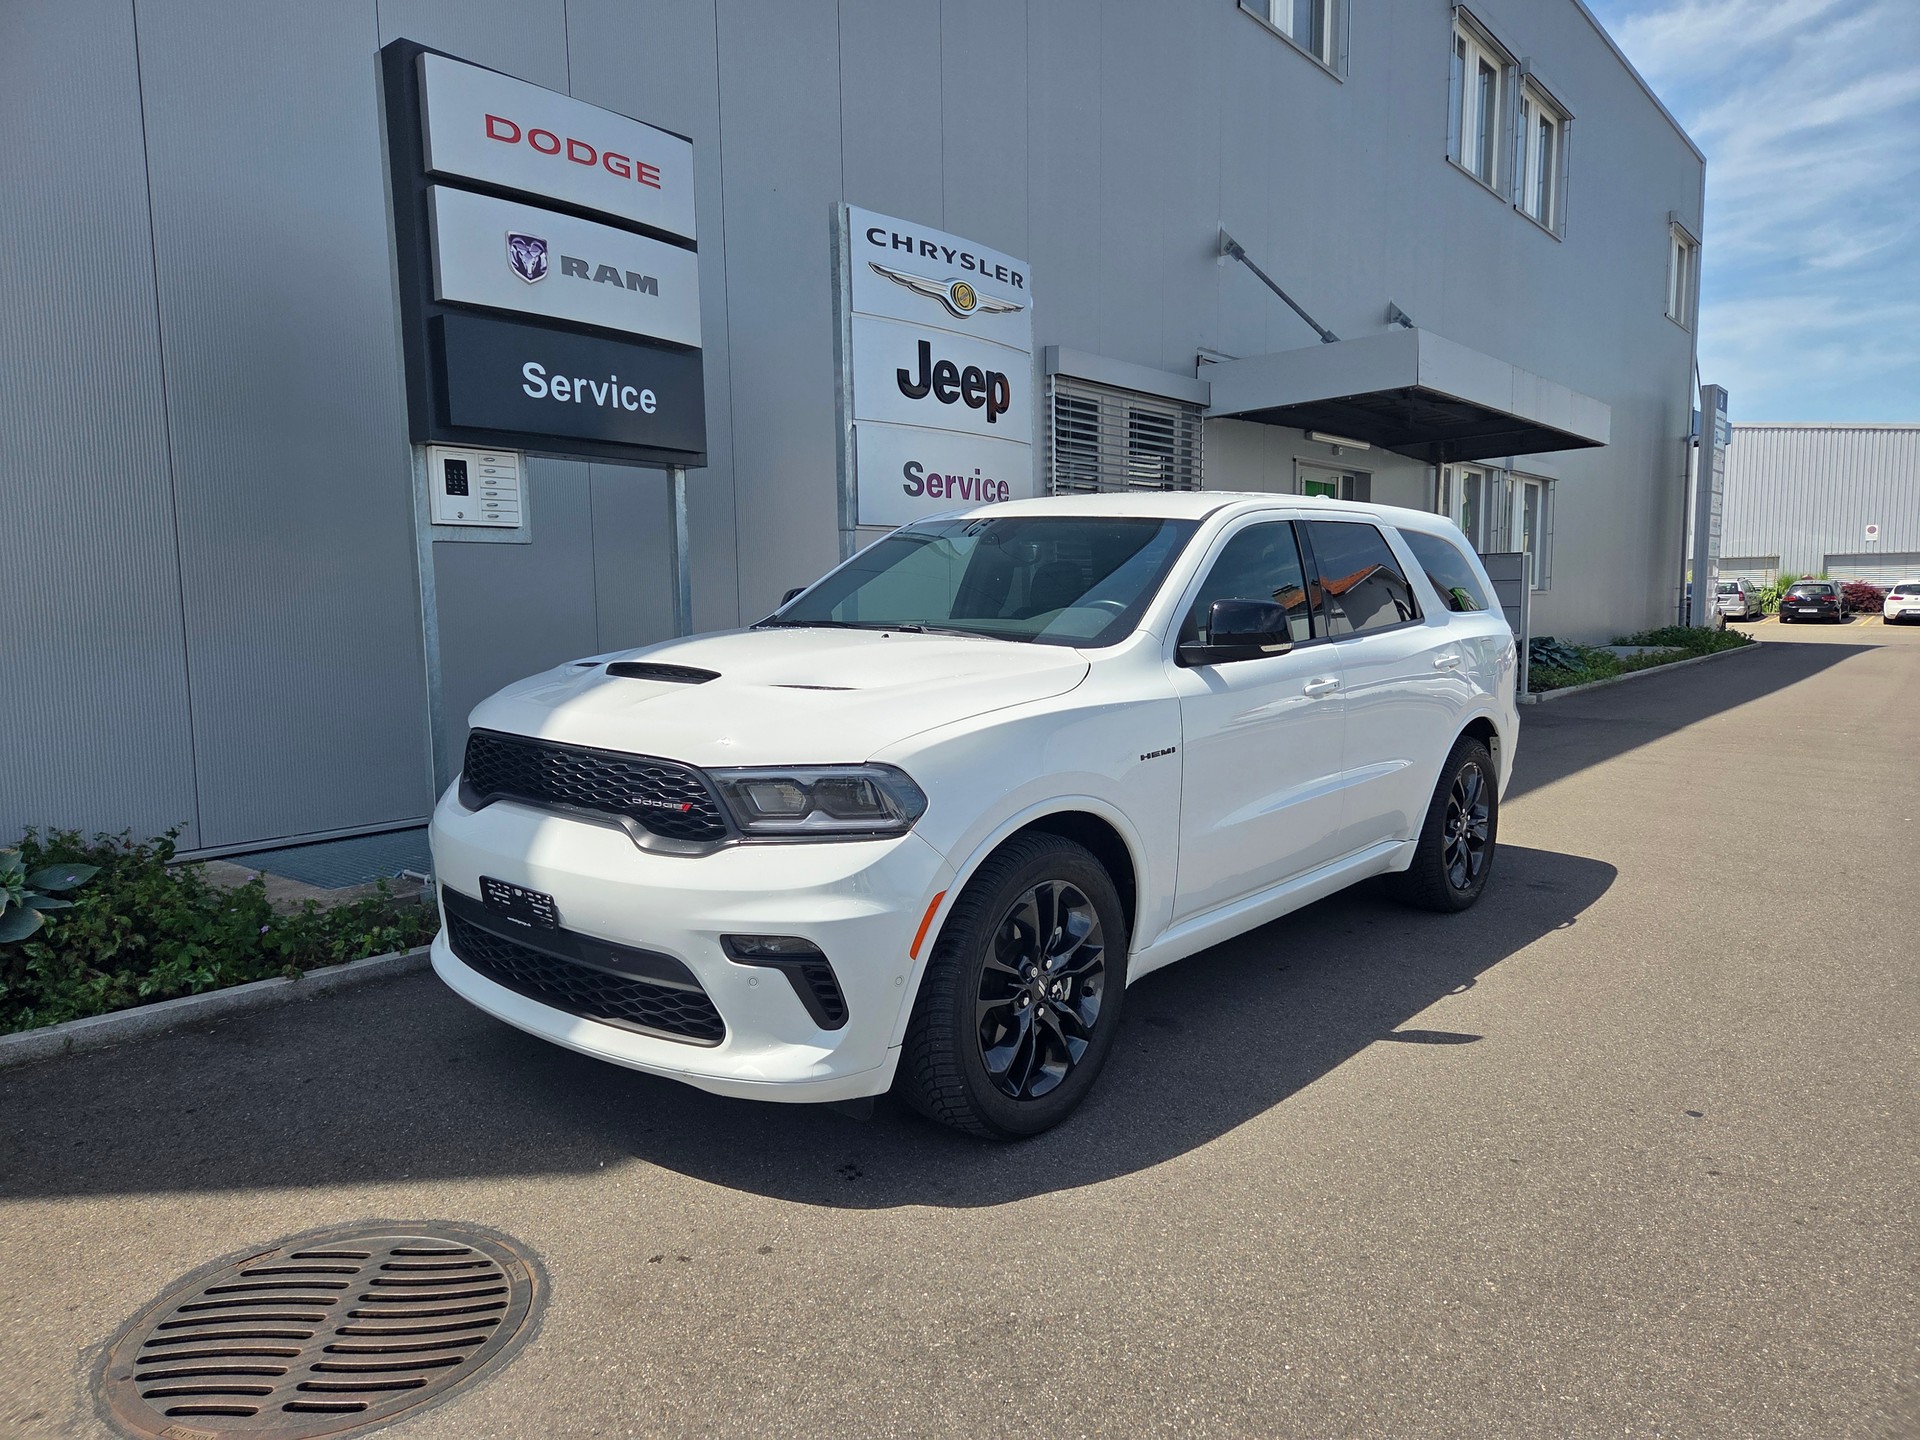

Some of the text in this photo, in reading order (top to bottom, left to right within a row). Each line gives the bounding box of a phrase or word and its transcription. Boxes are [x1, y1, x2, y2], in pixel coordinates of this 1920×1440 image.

[485, 113, 661, 189] DODGE
[560, 255, 659, 297] RAM
[866, 227, 1024, 289] CHRYSLER
[522, 361, 657, 414] Service
[896, 339, 1011, 424] Jeep
[902, 460, 1010, 502] Service
[1140, 746, 1176, 761] HEMI
[632, 798, 683, 810] DODGE
